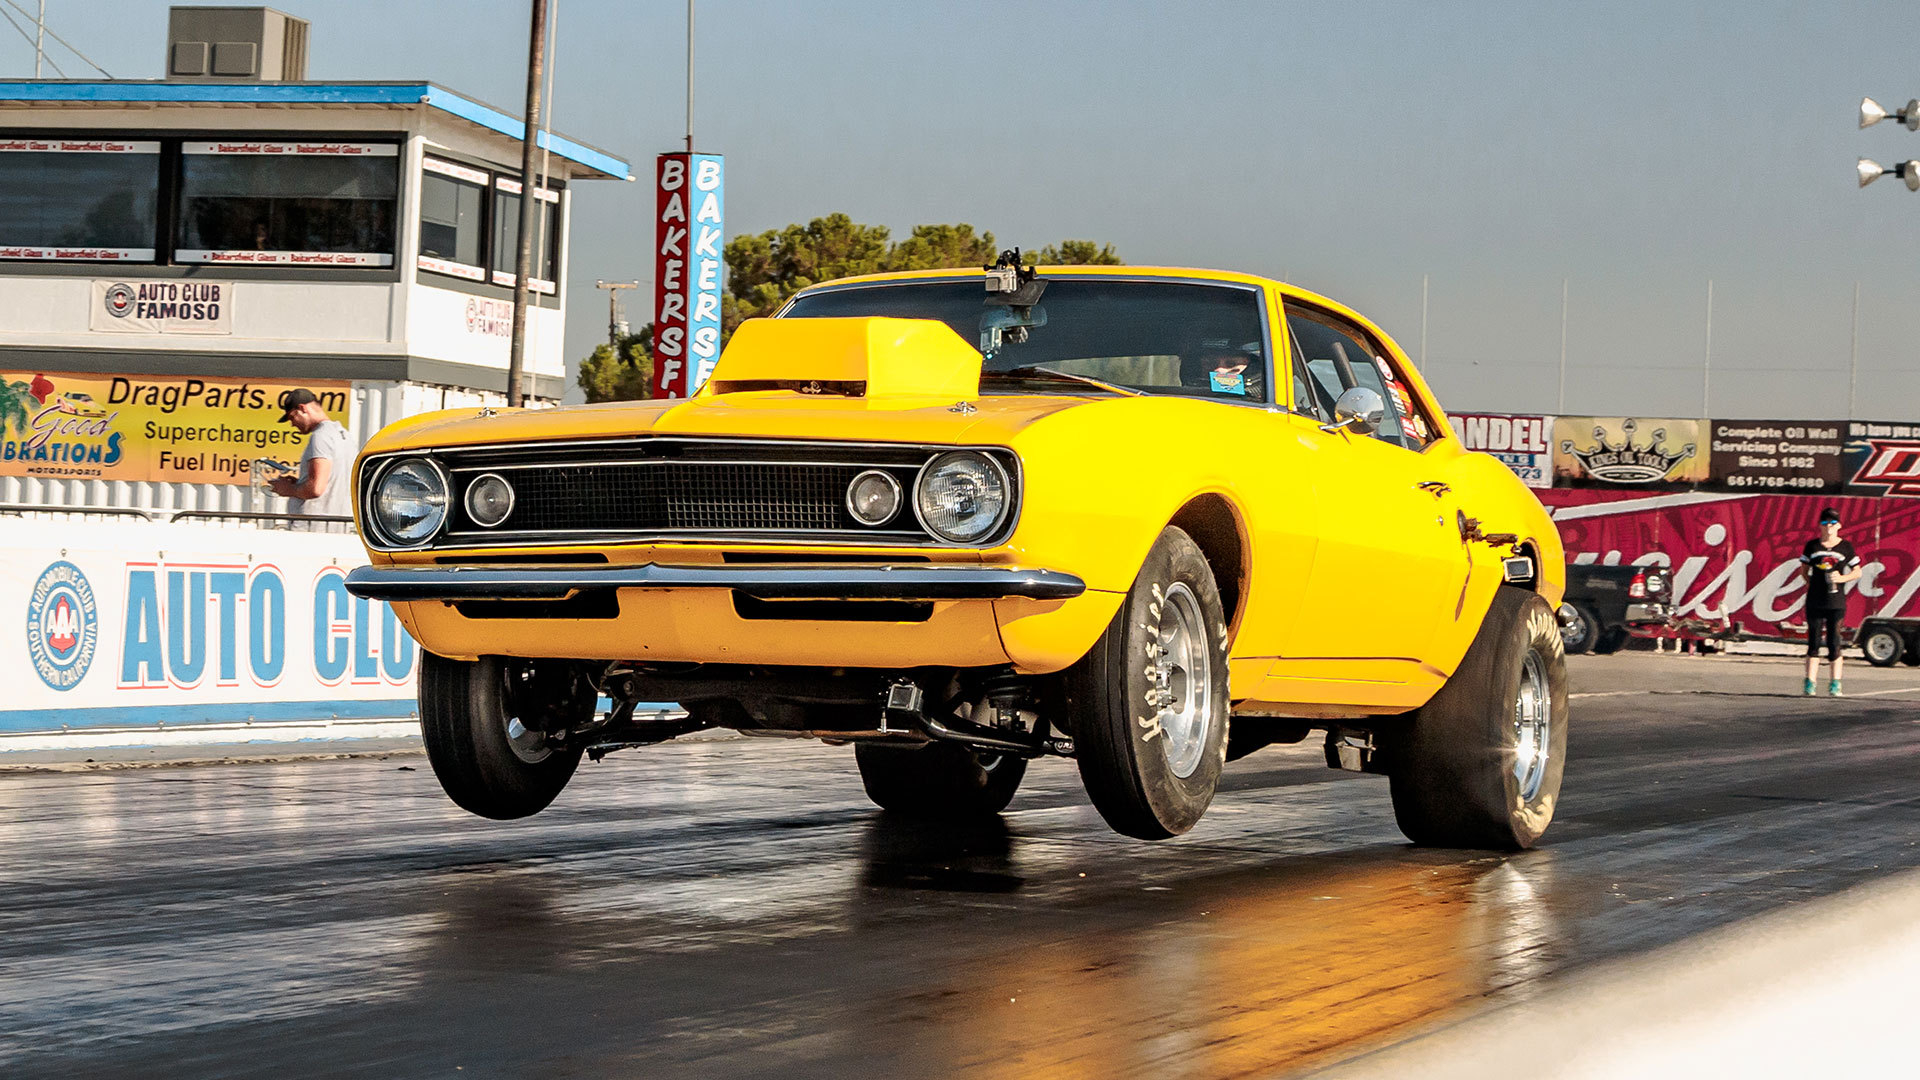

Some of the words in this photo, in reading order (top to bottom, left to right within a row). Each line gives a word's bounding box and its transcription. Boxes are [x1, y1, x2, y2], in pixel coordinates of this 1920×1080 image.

[138, 283, 178, 301] AUTO
[182, 283, 221, 302] CLUB
[137, 302, 220, 320] FAMOSO
[108, 377, 346, 413] DragParts.cm
[27, 404, 119, 449] Good
[144, 421, 302, 448] Superchargers
[1717, 426, 1782, 439] Complete
[1785, 427, 1805, 439] Oil
[1808, 428, 1838, 439] Well
[0, 432, 124, 467] BRATIONS
[1713, 440, 1776, 454] Servicing
[1778, 441, 1842, 455] Company
[160, 451, 205, 471] Fuel
[1739, 456, 1778, 468] Since
[26, 467, 102, 477] MOTORSPORTS
[46, 605, 80, 640] AAA
[118, 563, 286, 689] AUTO
